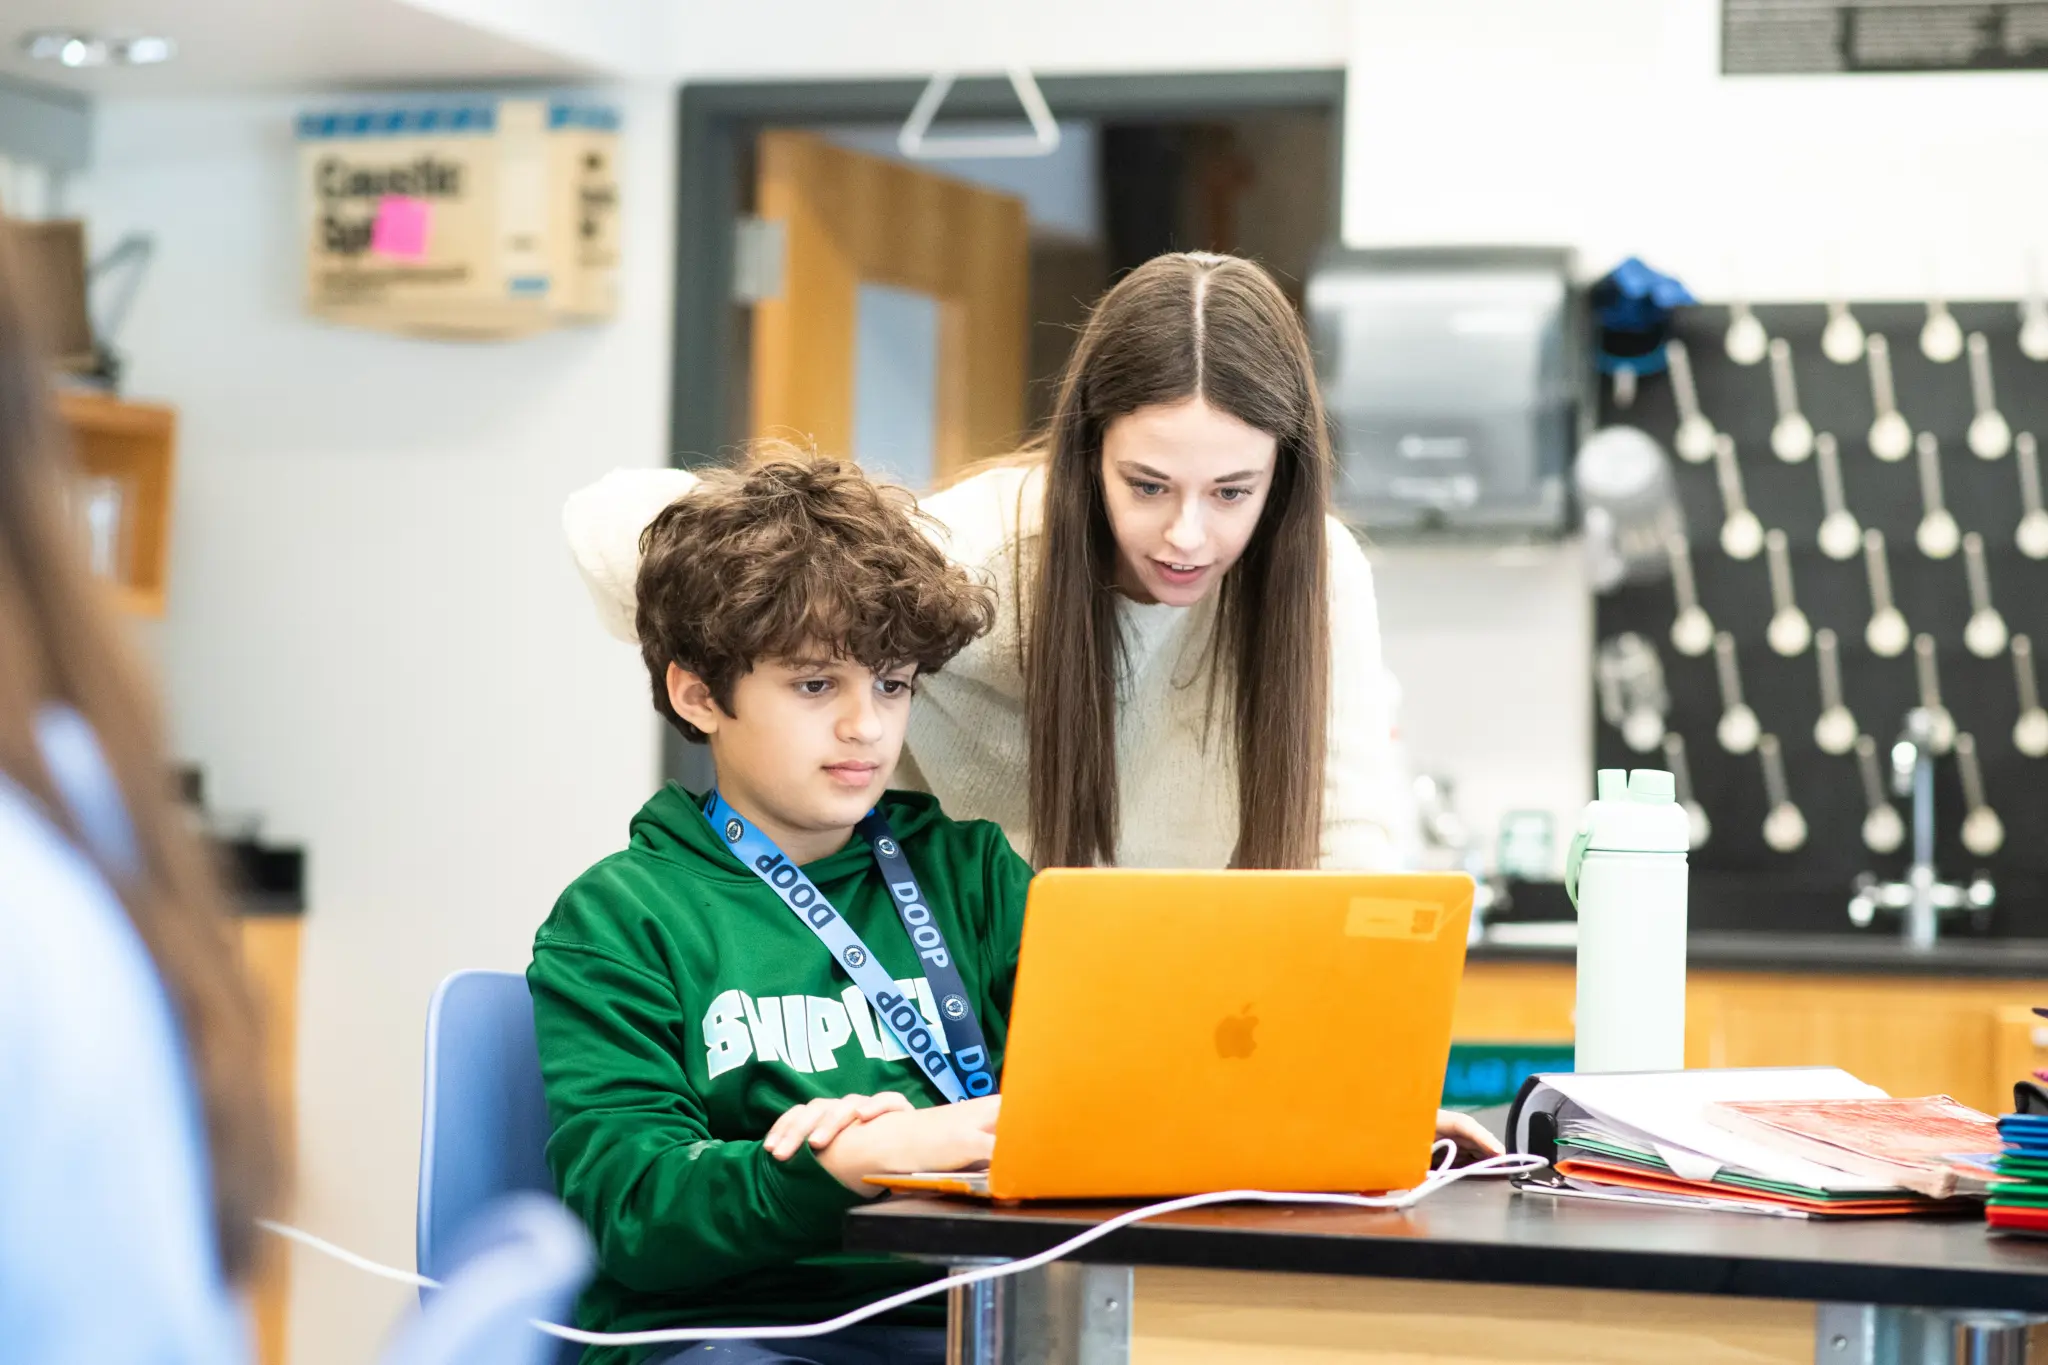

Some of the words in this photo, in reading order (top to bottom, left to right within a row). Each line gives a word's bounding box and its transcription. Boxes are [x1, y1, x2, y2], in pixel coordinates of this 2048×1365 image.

[755, 853, 837, 930] DOOP
[891, 880, 949, 968] DOOP
[875, 990, 948, 1078] DOOP
